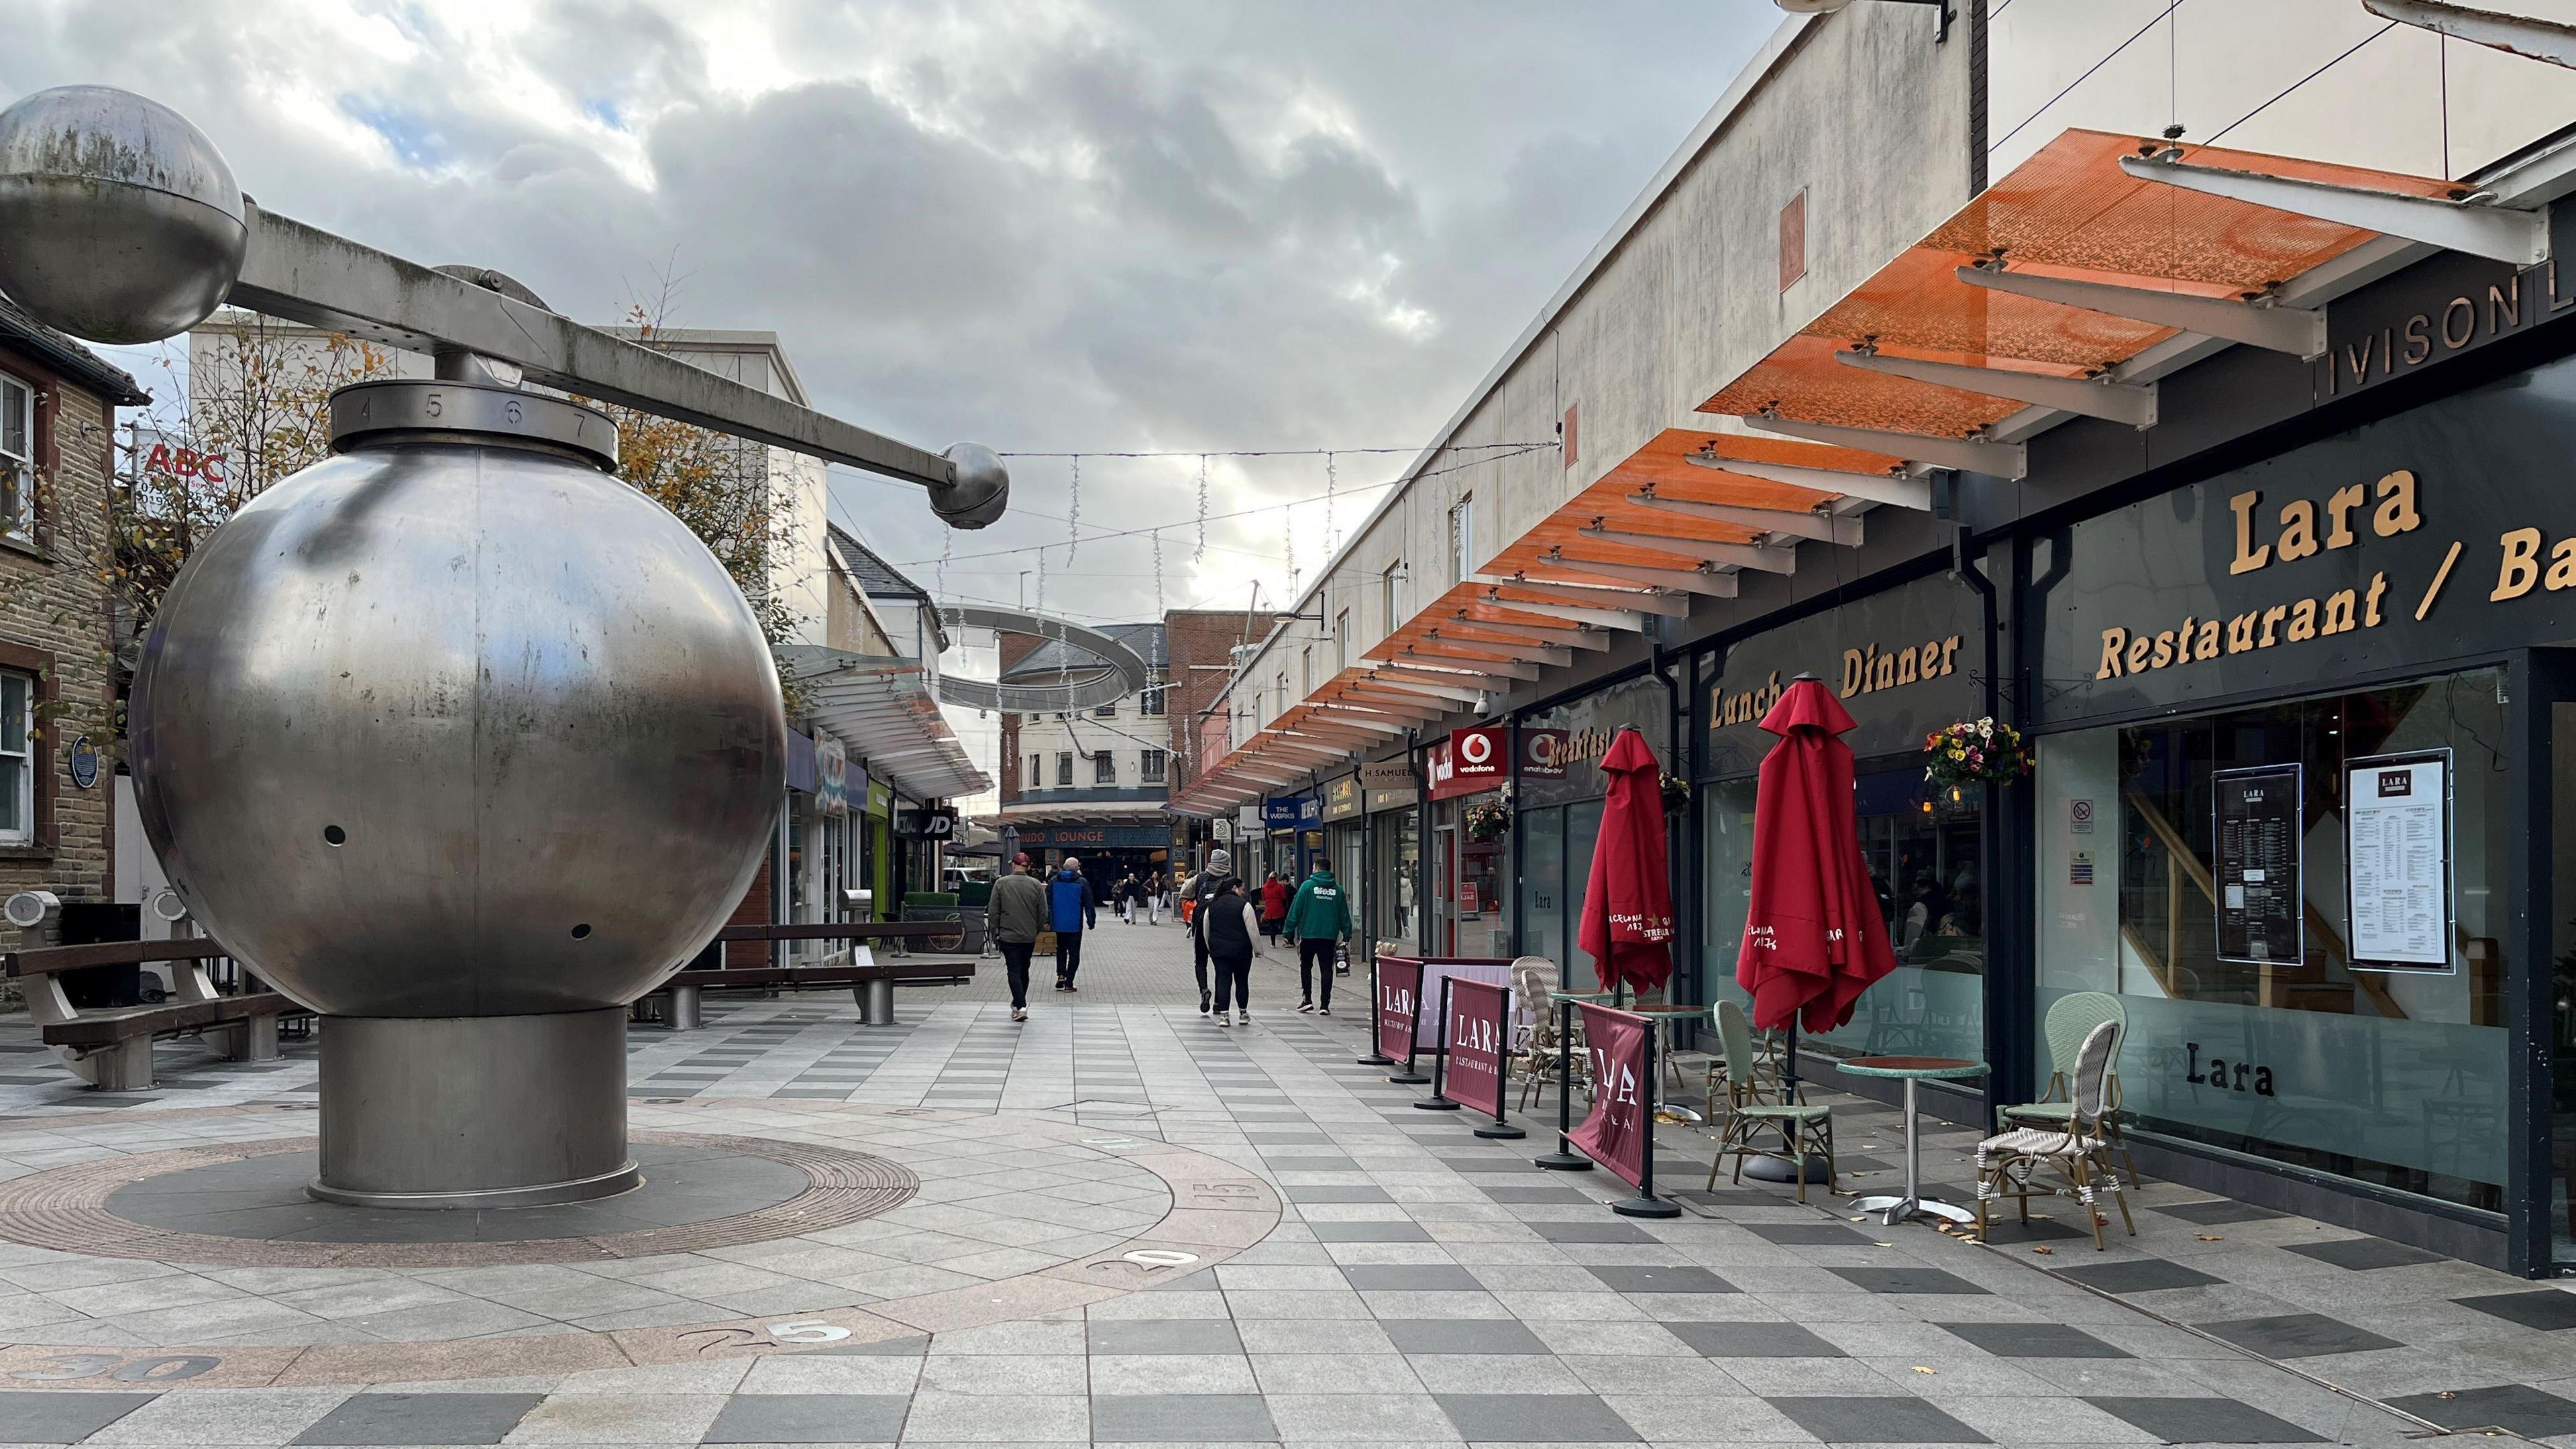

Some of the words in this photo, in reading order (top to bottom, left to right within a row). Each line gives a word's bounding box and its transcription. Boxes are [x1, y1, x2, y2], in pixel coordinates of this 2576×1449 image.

[2329, 274, 2518, 394] IVISON
[427, 394, 443, 417] 5
[504, 400, 523, 425] 6
[574, 413, 586, 437] 7
[145, 443, 227, 483] ABC
[2230, 470, 2420, 576] Lara
[2096, 571, 2389, 680] Restaurant
[1841, 635, 1960, 699] Dinner
[1710, 671, 1782, 729] Lunch
[1547, 727, 1613, 767] Breakfast
[1460, 765, 1495, 773] vodafone
[2382, 777, 2407, 786] LARA
[2243, 790, 2264, 798] LARA
[924, 816, 951, 833] JD
[1055, 831, 1104, 842] LOUNGE
[1535, 890, 1551, 908] Lara
[1643, 928, 1670, 938] STRELLA
[2186, 1042, 2275, 1097] Lara
[9, 1353, 222, 1383] 30
